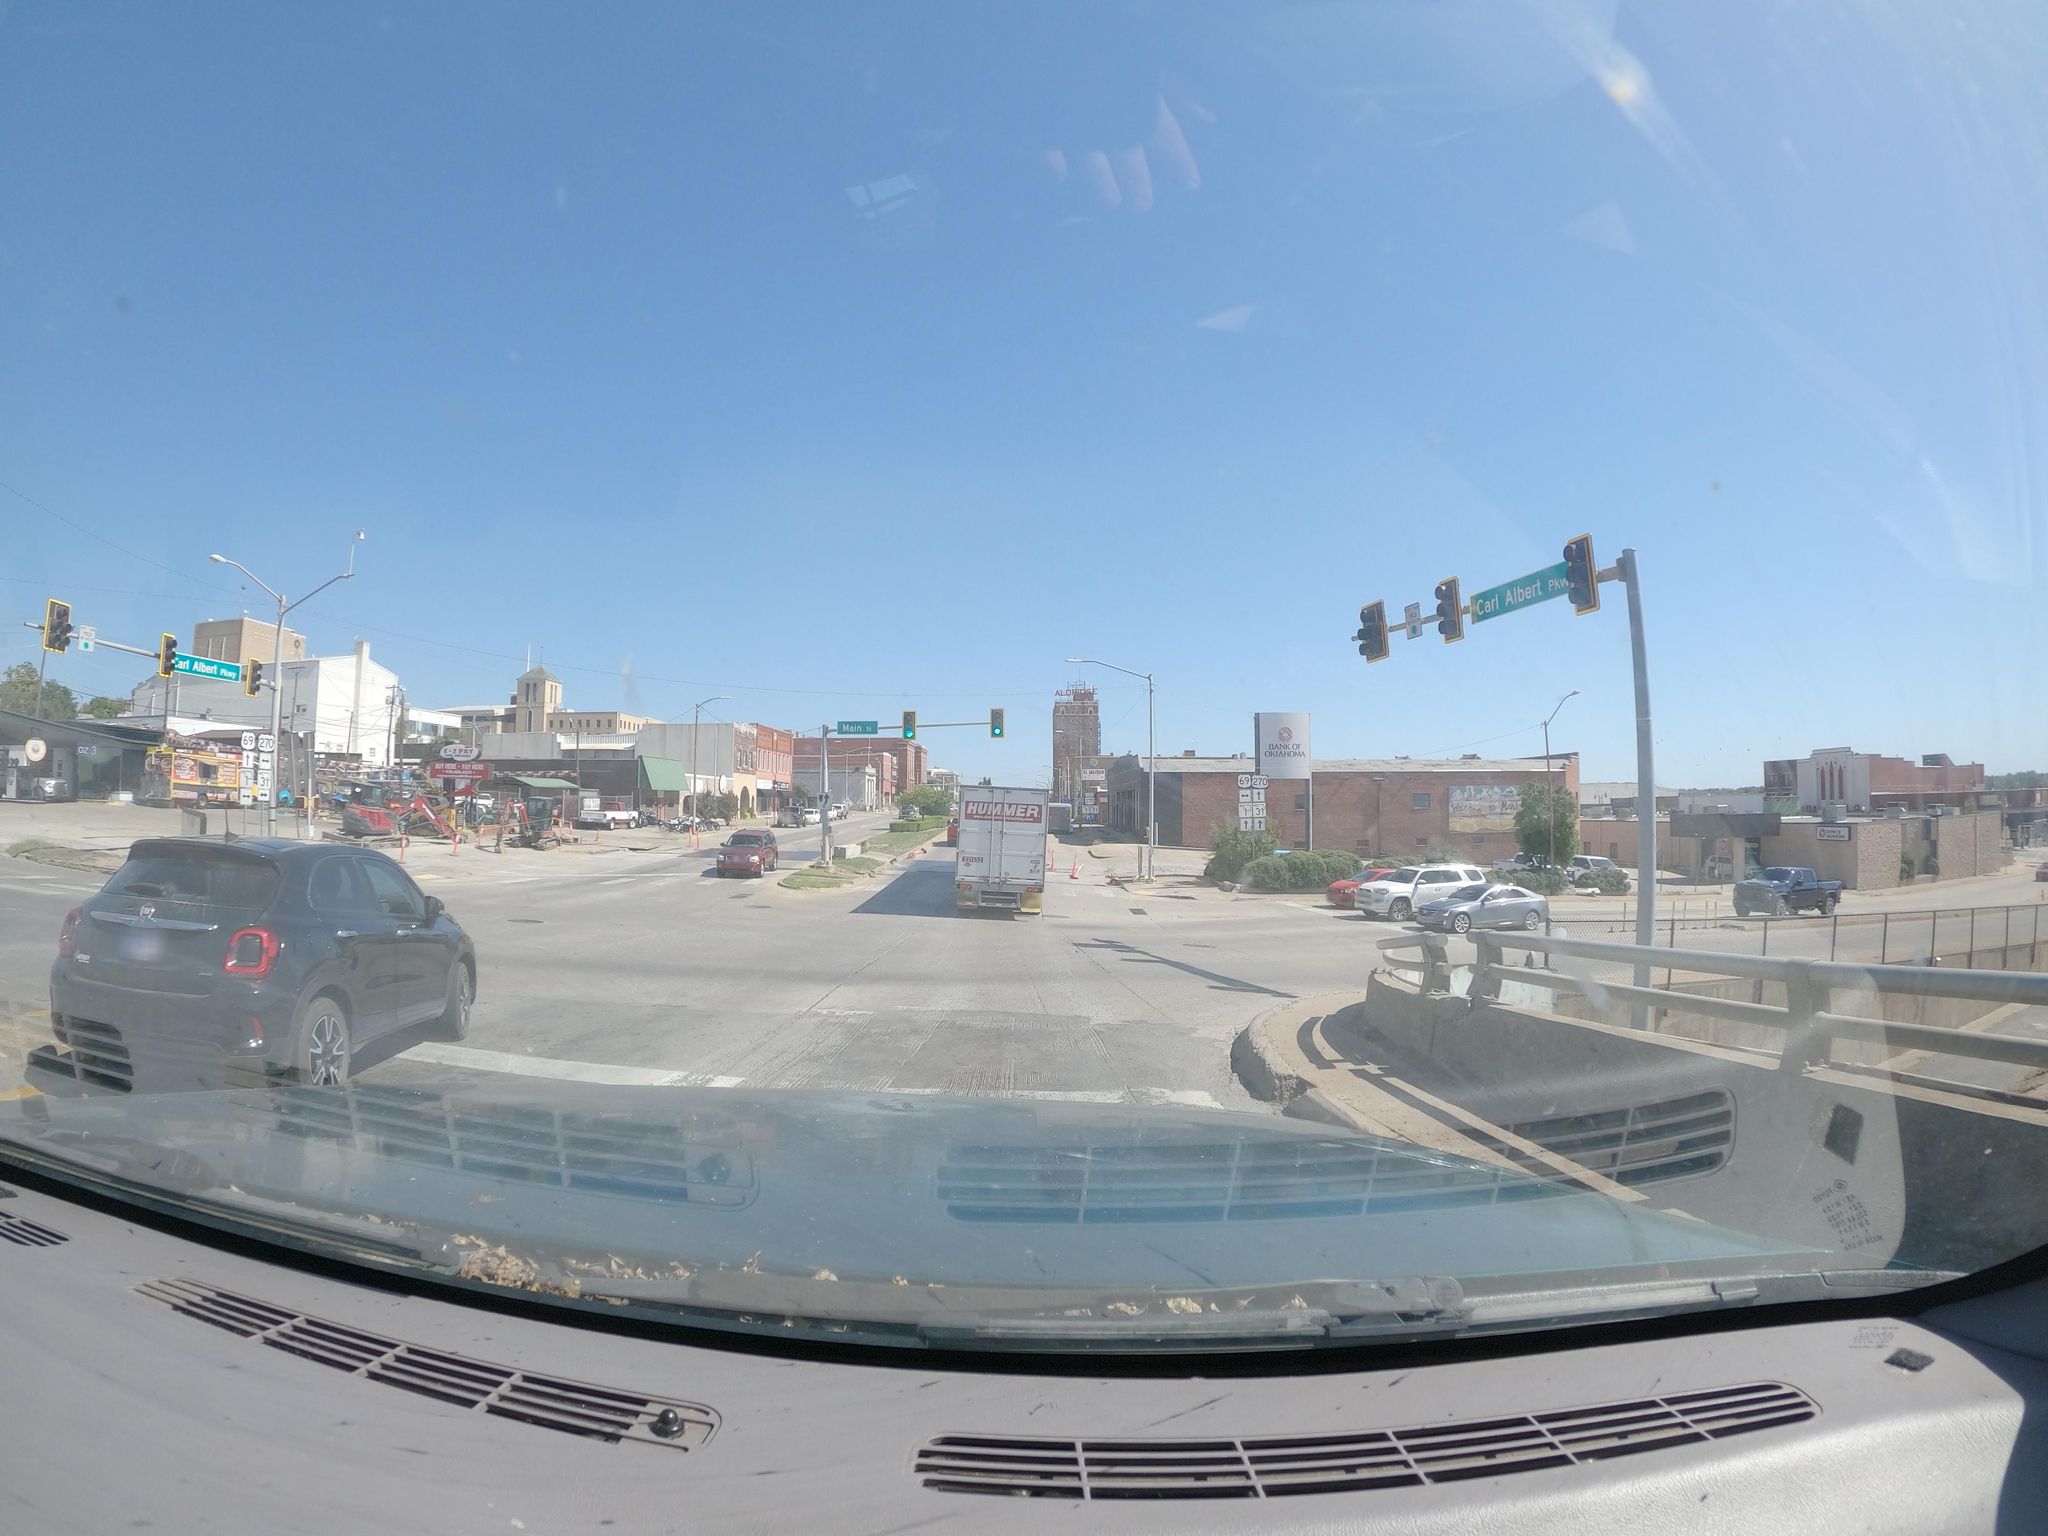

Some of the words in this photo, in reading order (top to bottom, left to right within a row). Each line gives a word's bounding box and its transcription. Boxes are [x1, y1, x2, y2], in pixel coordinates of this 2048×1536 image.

[1476, 594, 1499, 616] Carl
[1505, 579, 1542, 607] Albert
[1548, 577, 1569, 592] Pkw
[192, 661, 217, 675] Albert
[220, 668, 237, 680] Pkwy
[1054, 687, 1098, 696] ALDRIDGE
[842, 723, 862, 733] Main
[243, 735, 254, 746] 69
[259, 737, 274, 748] 270
[1268, 743, 1291, 751] BANK
[1264, 750, 1306, 758] OKLAHOMA
[259, 776, 269, 787] 31
[1239, 776, 1250, 785] 69
[1252, 777, 1267, 786] 270
[966, 802, 1040, 819] HUMMER
[1255, 807, 1265, 816] 31
